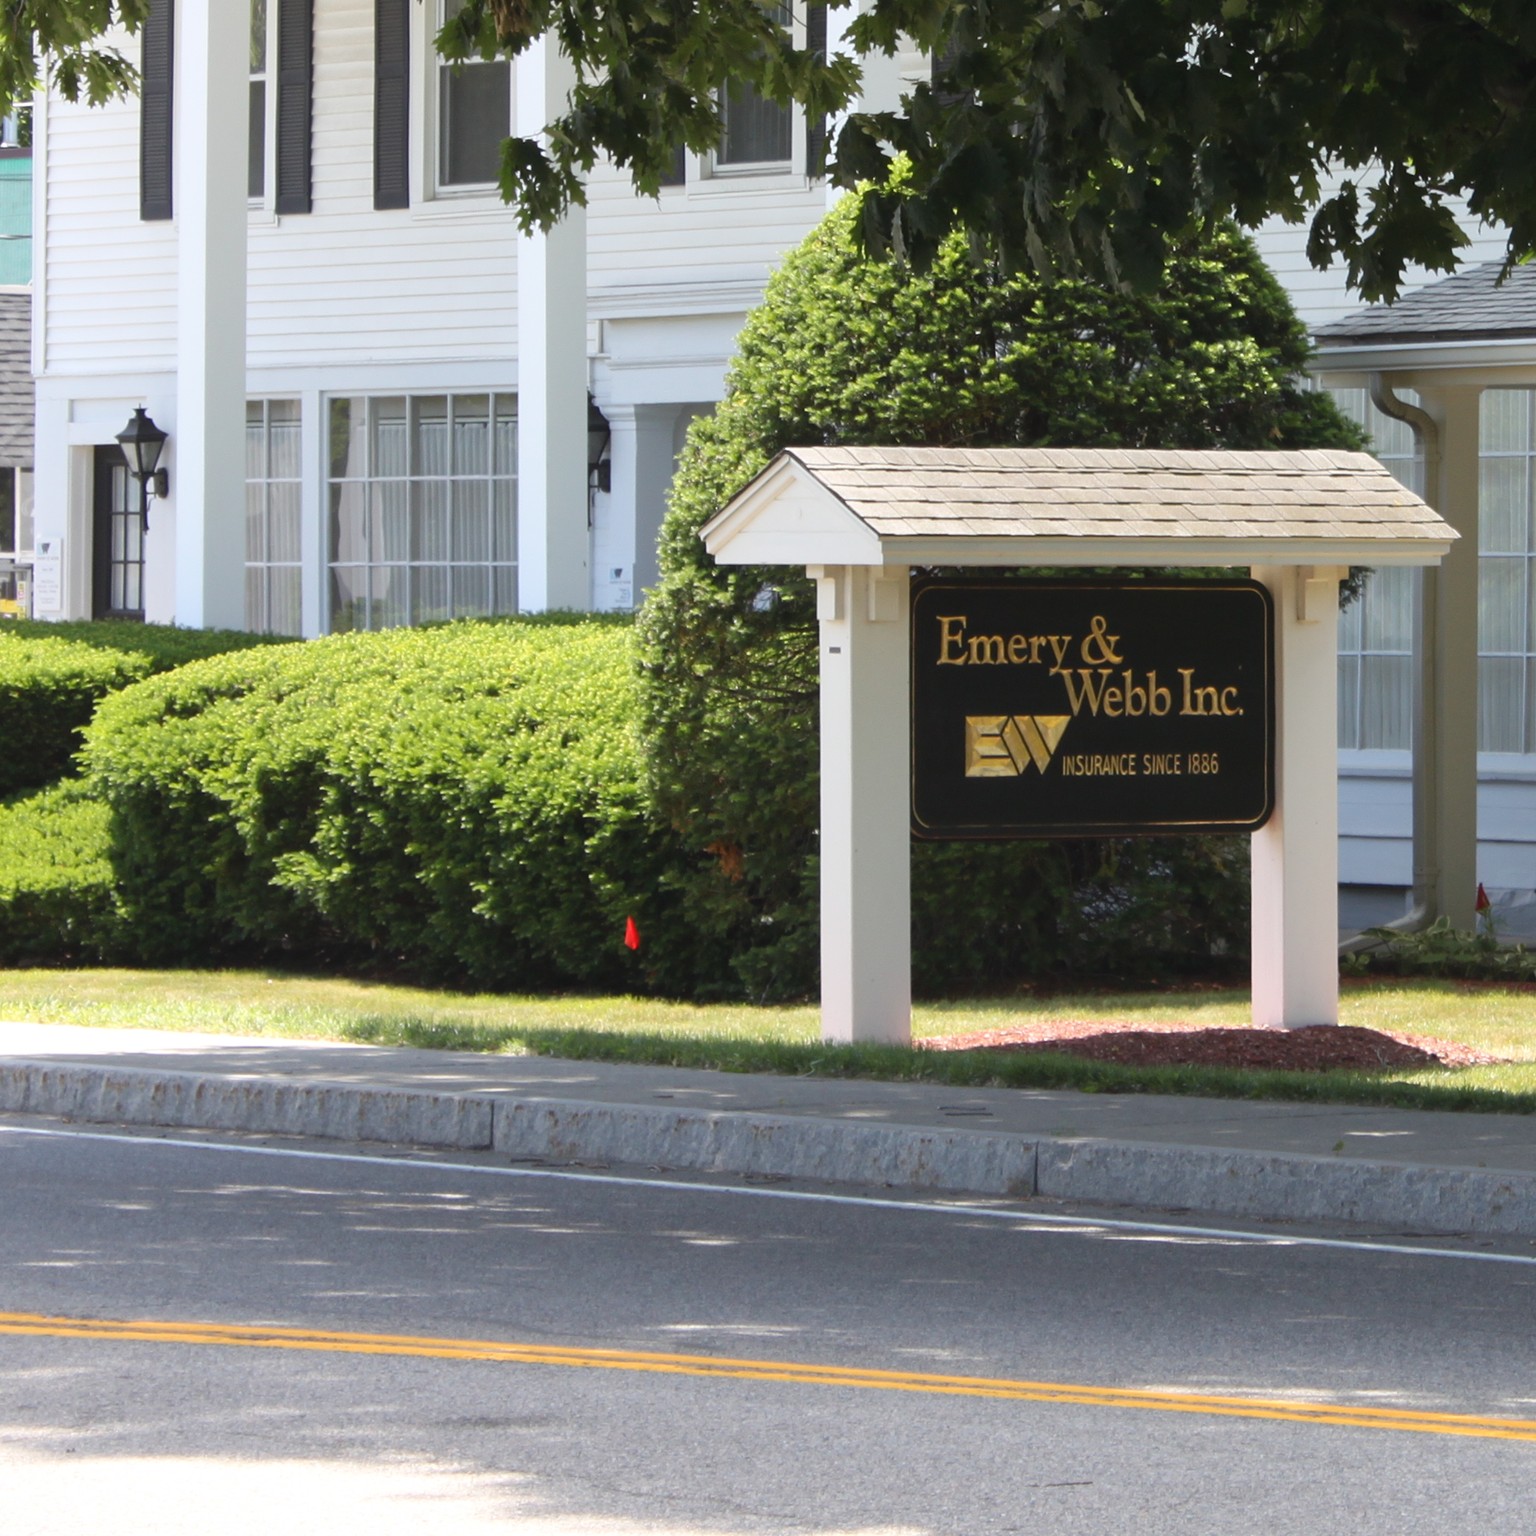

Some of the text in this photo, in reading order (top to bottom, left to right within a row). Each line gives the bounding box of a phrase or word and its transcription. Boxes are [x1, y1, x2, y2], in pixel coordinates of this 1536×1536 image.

[936, 615, 1124, 676] Emery &
[1058, 668, 1244, 717] Webb Inc.
[1062, 753, 1219, 776] INSURANCE SINCE 1886
